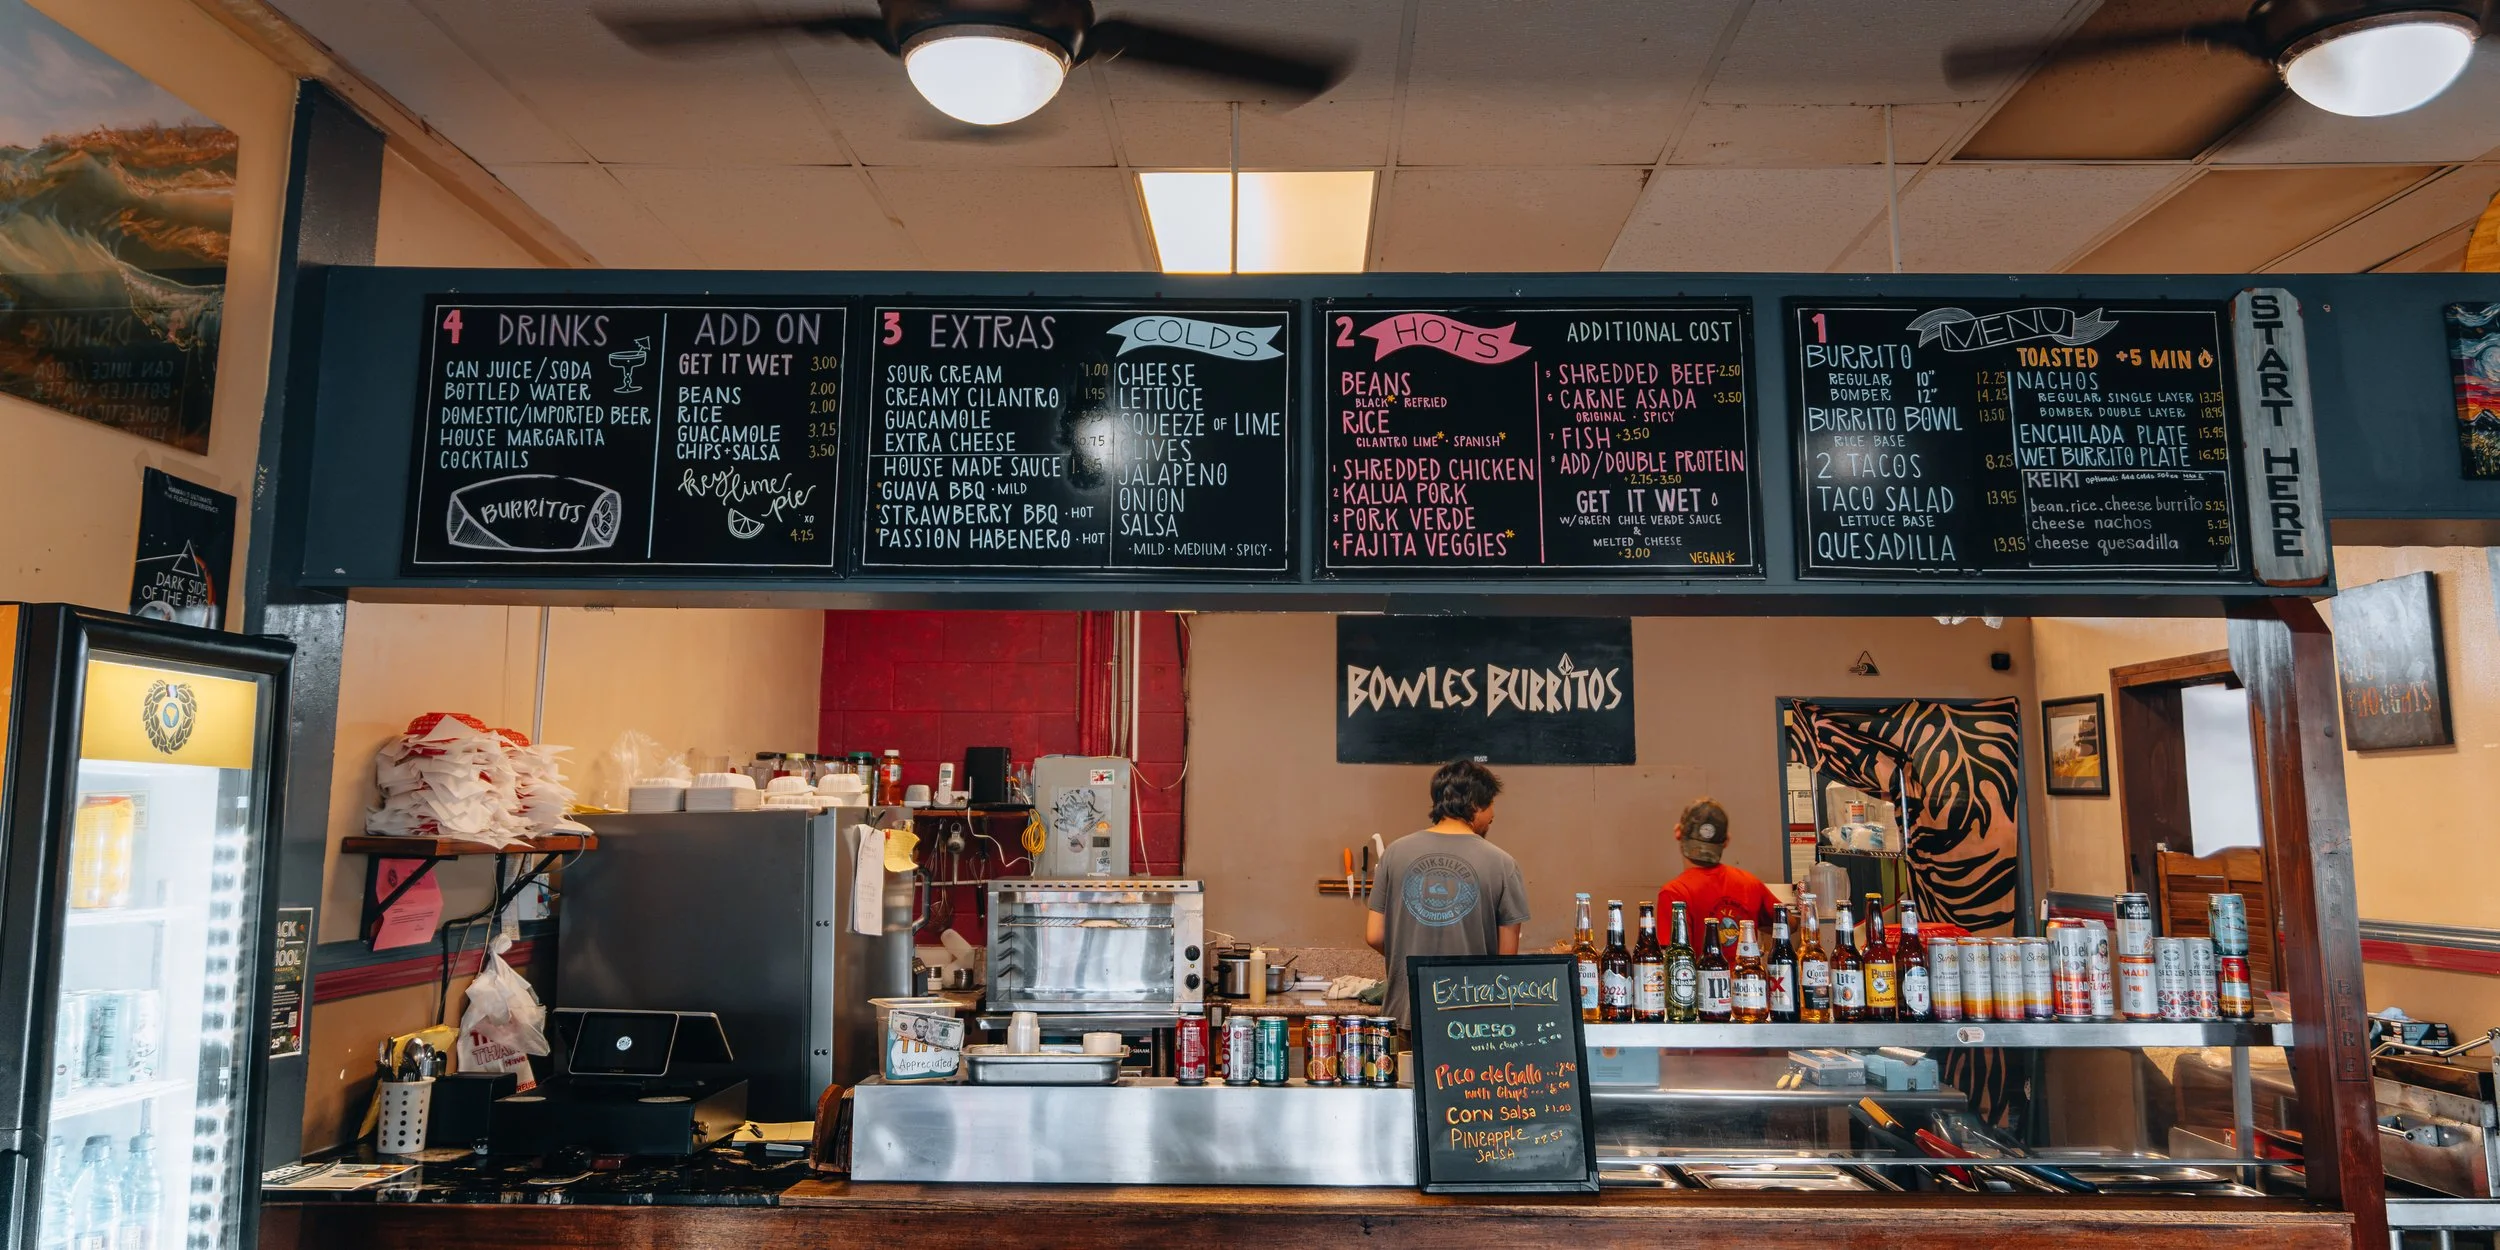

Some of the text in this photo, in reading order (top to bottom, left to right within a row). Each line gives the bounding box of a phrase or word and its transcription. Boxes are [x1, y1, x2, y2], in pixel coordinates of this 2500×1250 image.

[443, 309, 610, 346] 4 DRINKS
[694, 313, 821, 345] ADD ON
[882, 312, 1056, 350] 3 EXTRAS
[1133, 319, 1258, 356] COLDS
[1335, 315, 1499, 359] 2 HOTS
[1567, 321, 1732, 342] ADDITIONAL COST
[1811, 310, 2065, 348] 1 MENU
[679, 353, 837, 375] GET IT WET 3.00
[1806, 344, 1912, 369] BURRITO
[2016, 347, 2192, 369] TOASTED MIN
[446, 361, 479, 378] CAN
[887, 364, 1002, 384] SOUR CREAM
[1118, 363, 1195, 386] CHEESE
[1559, 363, 1716, 385] SHREDDED BEEF
[1828, 373, 1892, 386] REGULAR
[1341, 371, 1411, 396] BEANS
[2017, 371, 2099, 390] NACHOS
[445, 383, 591, 401] BOTTLED WATER
[678, 383, 835, 404] BEANS 2.00
[886, 387, 1059, 408] CREAMY CILANTRO
[1120, 387, 1203, 410] LETTUCE
[1404, 397, 1447, 408] REFRIED
[1560, 388, 1697, 410] CARNE ASADA
[1830, 389, 1891, 401] BOMBER
[2038, 392, 2193, 403] REGULAR SINGLE LAYER
[611, 406, 651, 425] BEER
[678, 399, 836, 423] RICE 2.00
[885, 409, 991, 430] GUACAMOLE
[1576, 411, 1675, 422] ORIGINAL SPICY
[1808, 406, 1963, 432] BURRITO BOWL
[2040, 407, 2186, 418] BOMBER DOUBLE LAYER
[1213, 412, 1280, 436] OF LIME
[1342, 410, 1390, 434] RICE
[2251, 295, 2304, 557] START HERE
[440, 429, 605, 446] HOUSE MARGARITA
[678, 425, 781, 443] GUACAMOLE
[885, 432, 1016, 452] EXTRA CHEESE
[1356, 436, 1408, 448] CILANTRO
[1562, 427, 1611, 449] FISH
[1834, 434, 1906, 447] RICE BASE
[2020, 424, 2188, 445] ENCHILADA PLATE
[440, 451, 529, 469] COCKTAILS
[809, 444, 835, 458] 3.50
[1675, 450, 1745, 472] PROTEIN
[2020, 447, 2191, 467] WET BURRITO PLATE
[884, 457, 1061, 477] HOUSE MADE SAUCE
[1343, 458, 1534, 481] SHREDDED CHICKEN
[1816, 453, 1921, 479] 2 TACOS
[2027, 471, 2080, 489] KEIKI
[882, 481, 1027, 501] GUAVA BBQ MILD
[1119, 488, 1185, 512] ONION
[1343, 482, 1468, 505] KALUA PORK
[1576, 488, 1702, 514] GET IT WET
[1817, 486, 1954, 513] TACO SALAD
[481, 498, 585, 524] BURRITOS
[2156, 495, 2202, 512] burrito
[880, 504, 1094, 525] STRAWBERRY BBQ HOT
[1120, 513, 1179, 537] SALSA
[1343, 506, 1476, 531] PORK VERDE
[1618, 514, 1722, 525] CHILE VERDE SAUCE
[1840, 515, 1935, 527] LETTUCE BASE
[2032, 514, 2152, 530] cheese nachos
[790, 529, 814, 541] 4.25
[879, 528, 1105, 550] PASSION HABENERO HOT
[1343, 533, 1416, 556] FAJITA
[1593, 536, 1682, 546] MELTED CHEESE
[2035, 533, 2178, 556] cheese quesadilla
[1818, 532, 1956, 561] QUESADILLA
[156, 572, 208, 596] DARK SIDE
[142, 585, 182, 606] OF THE
[1348, 655, 1622, 718] BOWLES BURRITOS
[1412, 857, 1471, 880] QUIKSILVER
[2127, 905, 2149, 915] MAUI
[1836, 972, 1856, 985] Lite
[2122, 969, 2149, 977] MAUI
[899, 1057, 952, 1071] Appreciated
[1505, 1062, 1542, 1086] Gallo
[1848, 1071, 1863, 1080] poly
[1500, 1105, 1536, 1121] Salsa
[1475, 1148, 1515, 1163] SALSA
